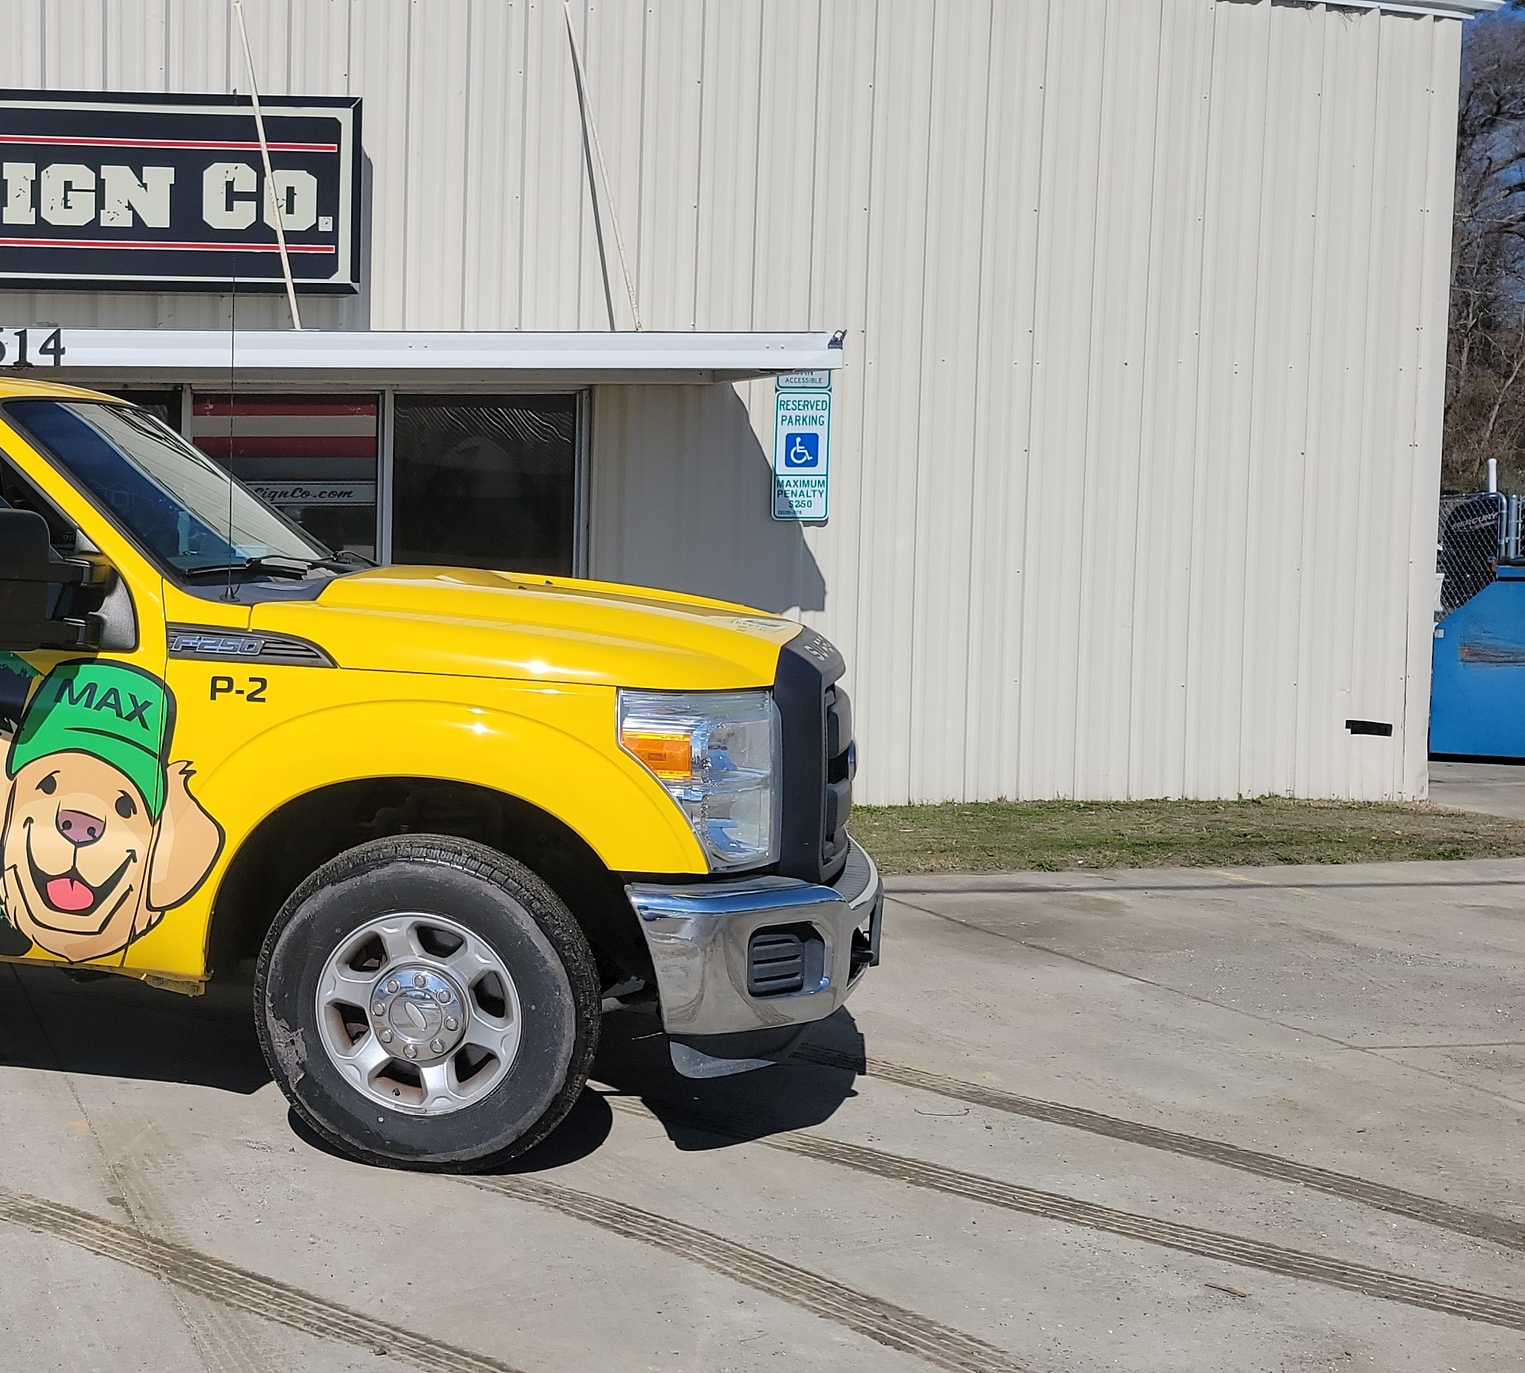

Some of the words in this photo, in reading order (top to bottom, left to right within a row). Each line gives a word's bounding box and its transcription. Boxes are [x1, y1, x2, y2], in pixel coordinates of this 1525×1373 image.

[202, 162, 333, 231] CO.
[779, 399, 828, 411] RESERVED
[780, 414, 825, 427] PARKING
[776, 479, 826, 488] MAXIMUM
[777, 489, 824, 498] PENALTY
[788, 499, 813, 509] $250
[172, 635, 265, 656] F-250
[210, 676, 268, 703] P-2
[54, 679, 153, 732] MAX
